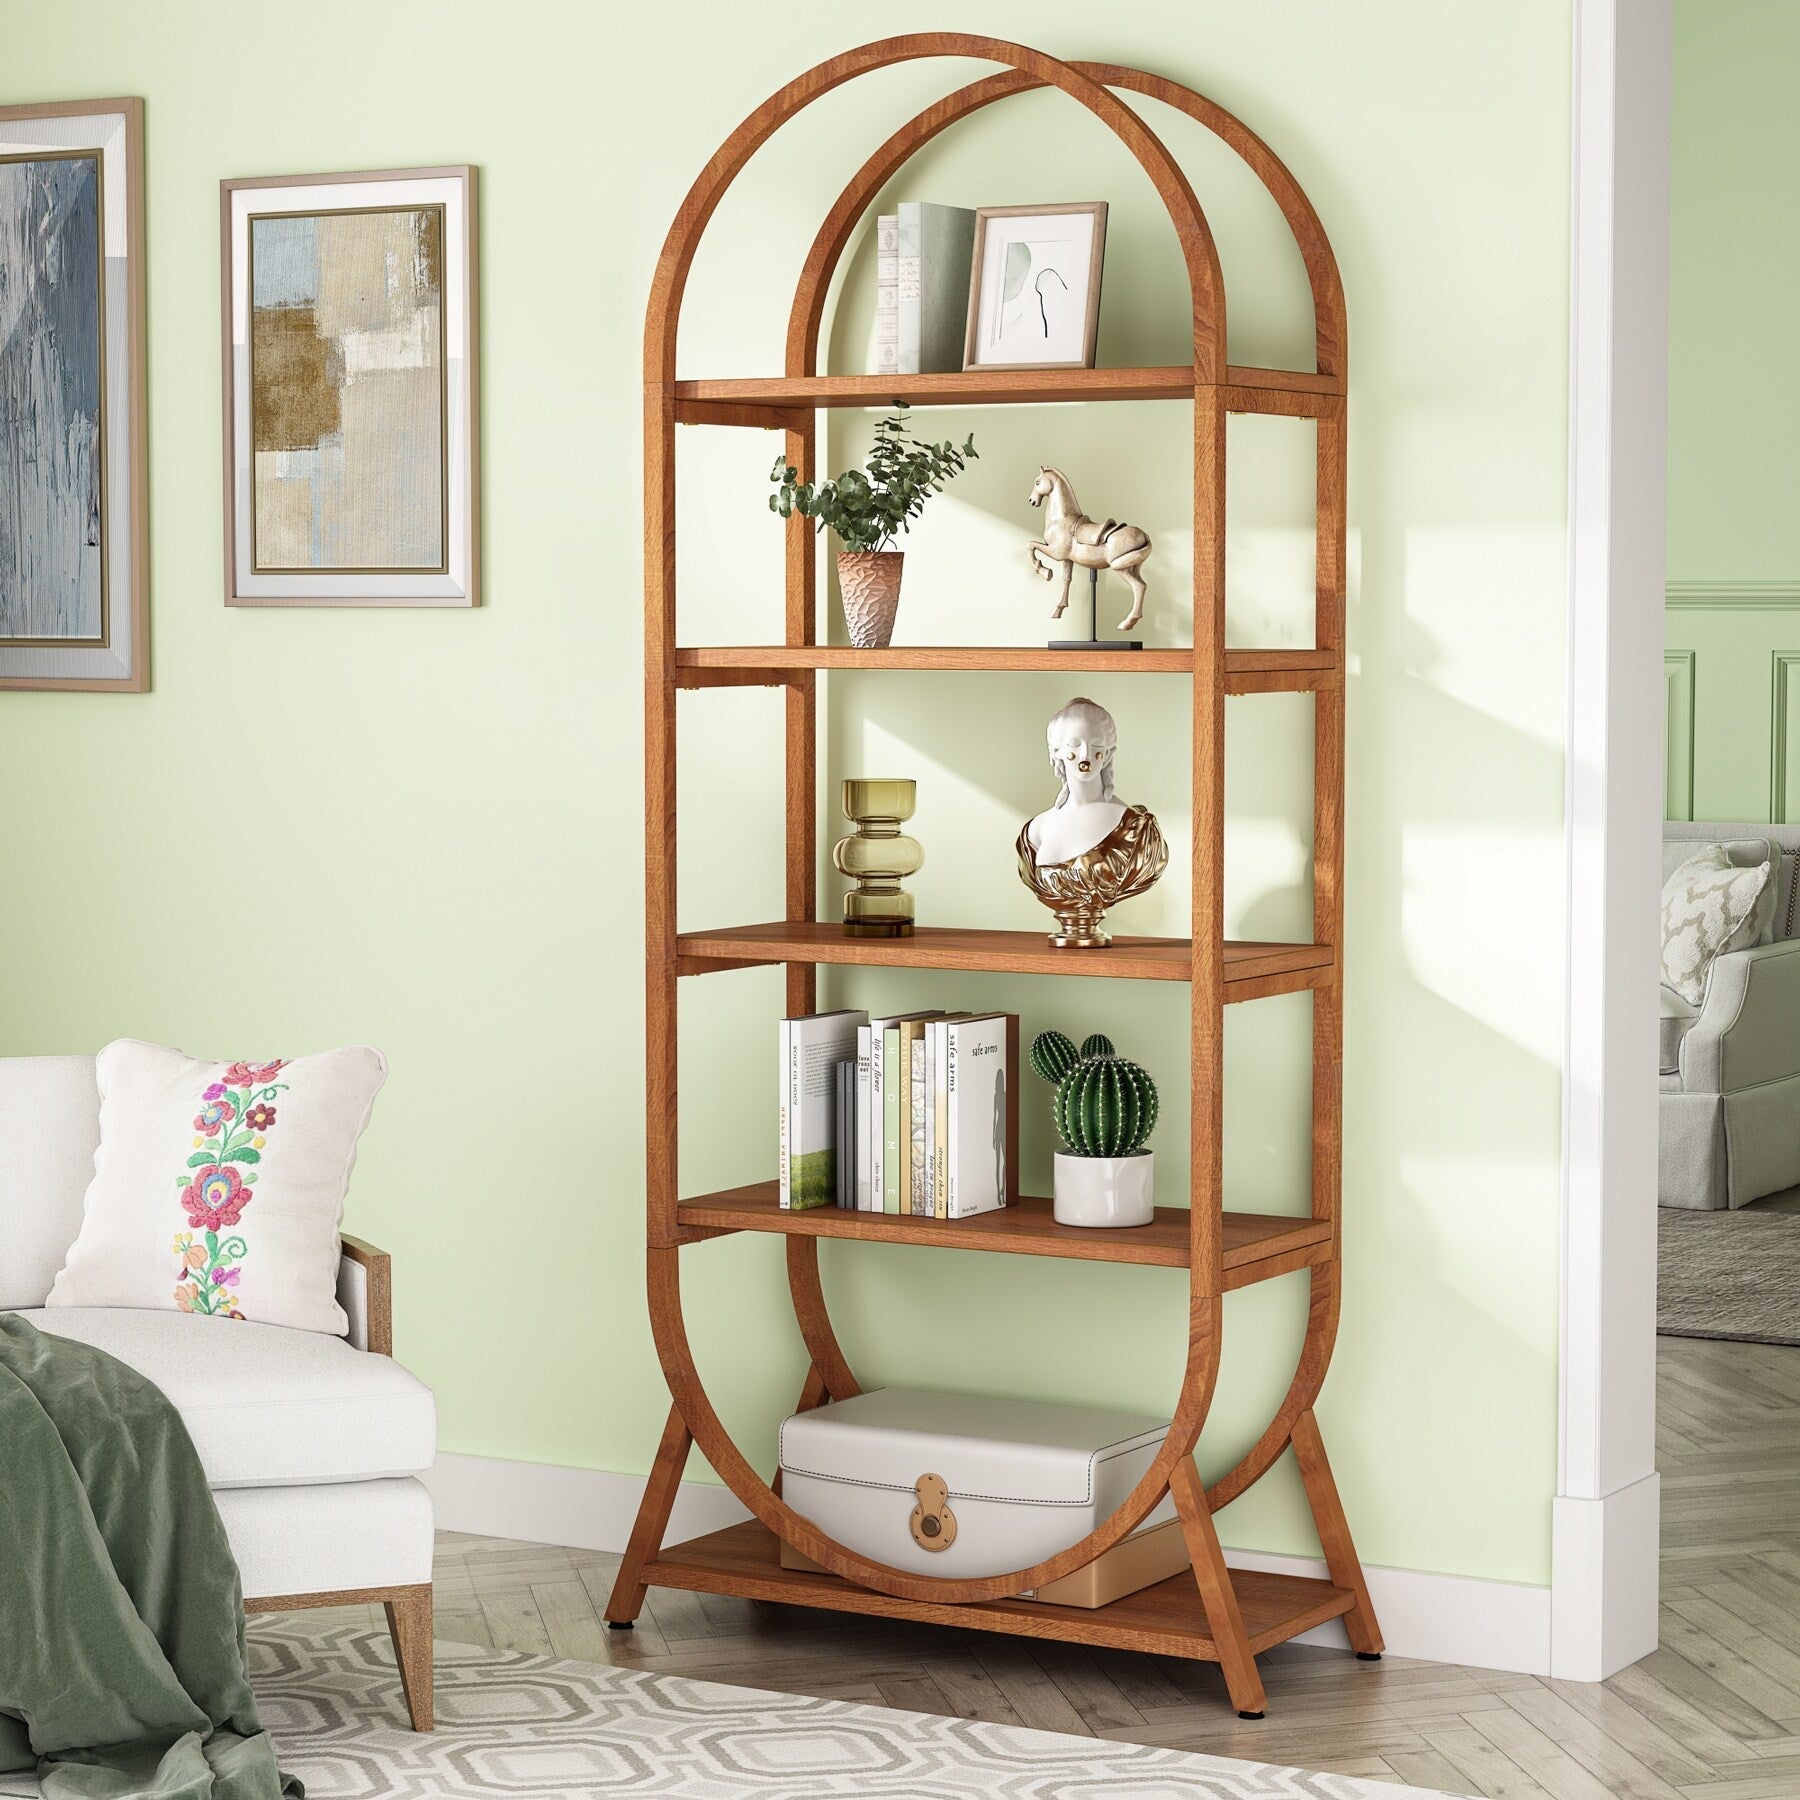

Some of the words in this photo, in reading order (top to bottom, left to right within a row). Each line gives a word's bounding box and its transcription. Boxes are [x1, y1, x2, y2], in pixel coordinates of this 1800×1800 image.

[872, 1038, 882, 1051] life
[949, 1034, 958, 1058] safe
[972, 1042, 983, 1057] safe
[984, 1044, 998, 1055] arms
[872, 1068, 882, 1092] flower
[887, 1047, 896, 1195] HOME
